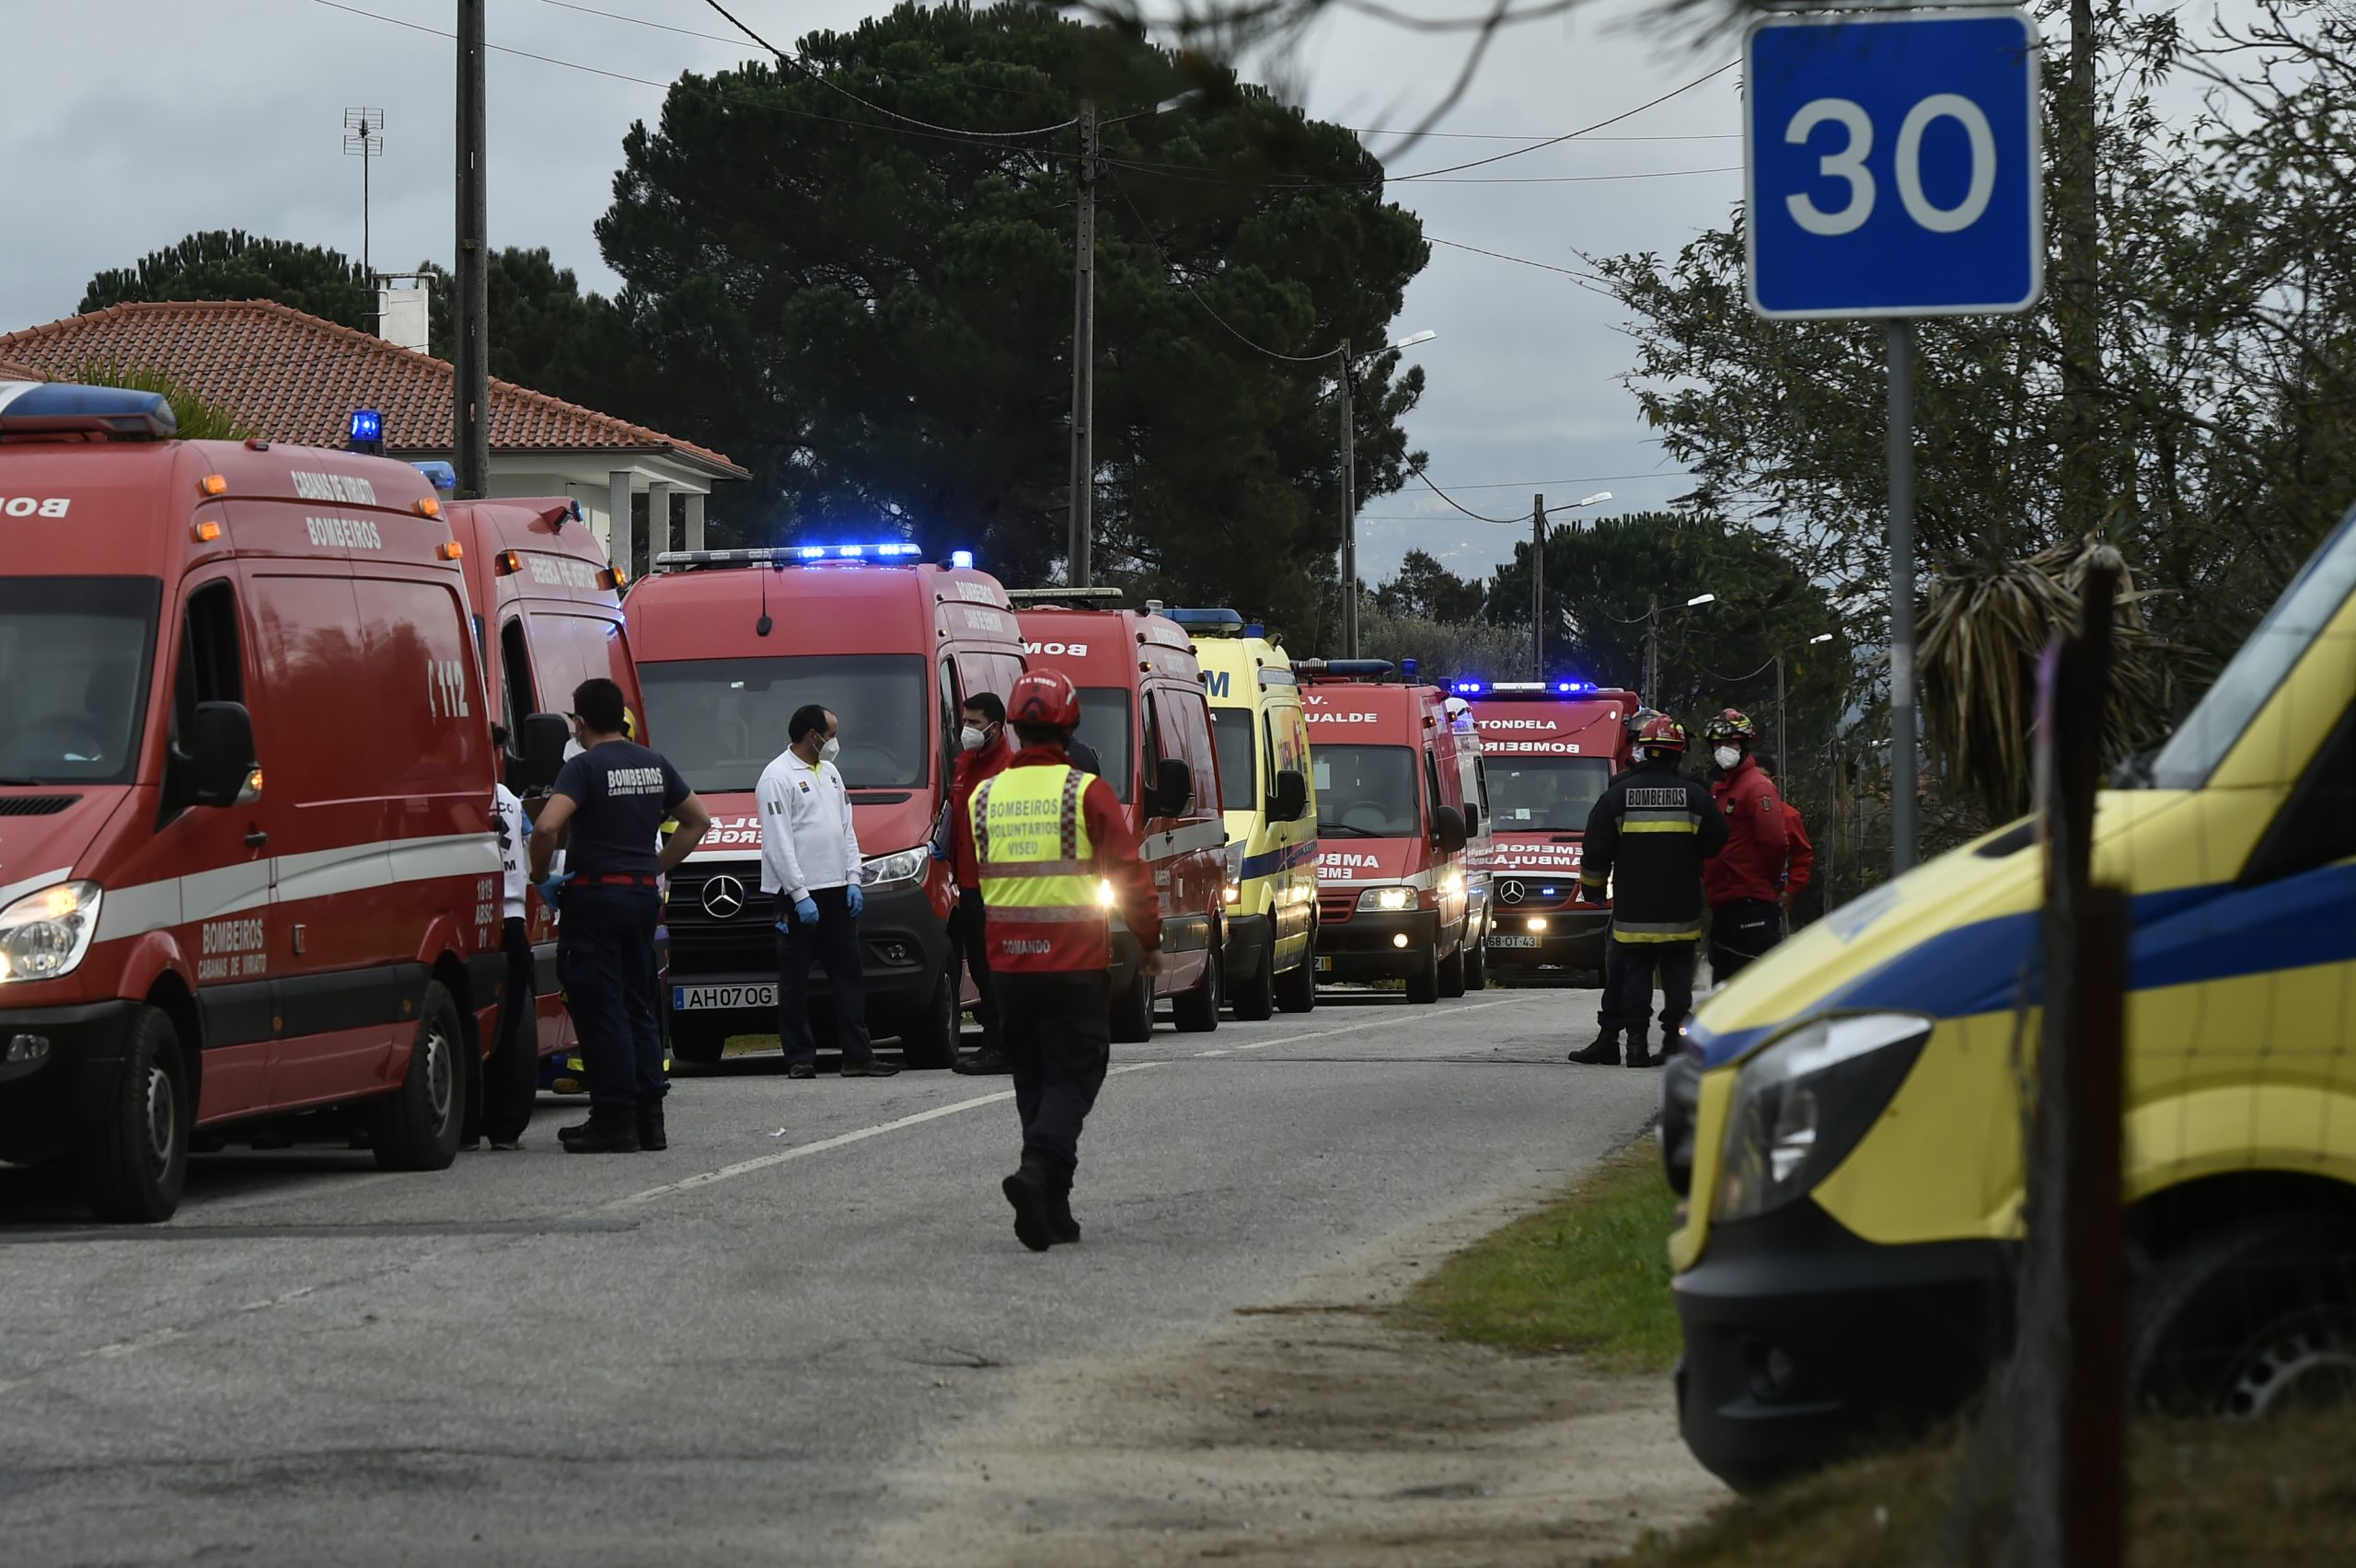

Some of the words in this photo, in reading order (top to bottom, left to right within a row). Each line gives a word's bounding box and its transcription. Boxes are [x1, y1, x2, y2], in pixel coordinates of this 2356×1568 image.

[1784, 93, 1997, 236] 30
[306, 517, 382, 549] BOMBEIROS
[438, 660, 469, 717] 112
[1202, 670, 1230, 698] M
[1304, 712, 1378, 722] UALDE
[1478, 720, 1557, 730] TONDELA
[607, 767, 663, 789] BOMBEIROS
[1628, 789, 1684, 806] BOMBEIROS
[990, 799, 1058, 819] BOMBEIROS
[1008, 841, 1037, 856] VISEU
[503, 859, 516, 871] M
[477, 879, 493, 902] 1819
[475, 904, 494, 926] ABSC
[202, 918, 263, 955] BOMBEIROS
[479, 927, 488, 950] 01
[1002, 940, 1050, 954] COMANDO
